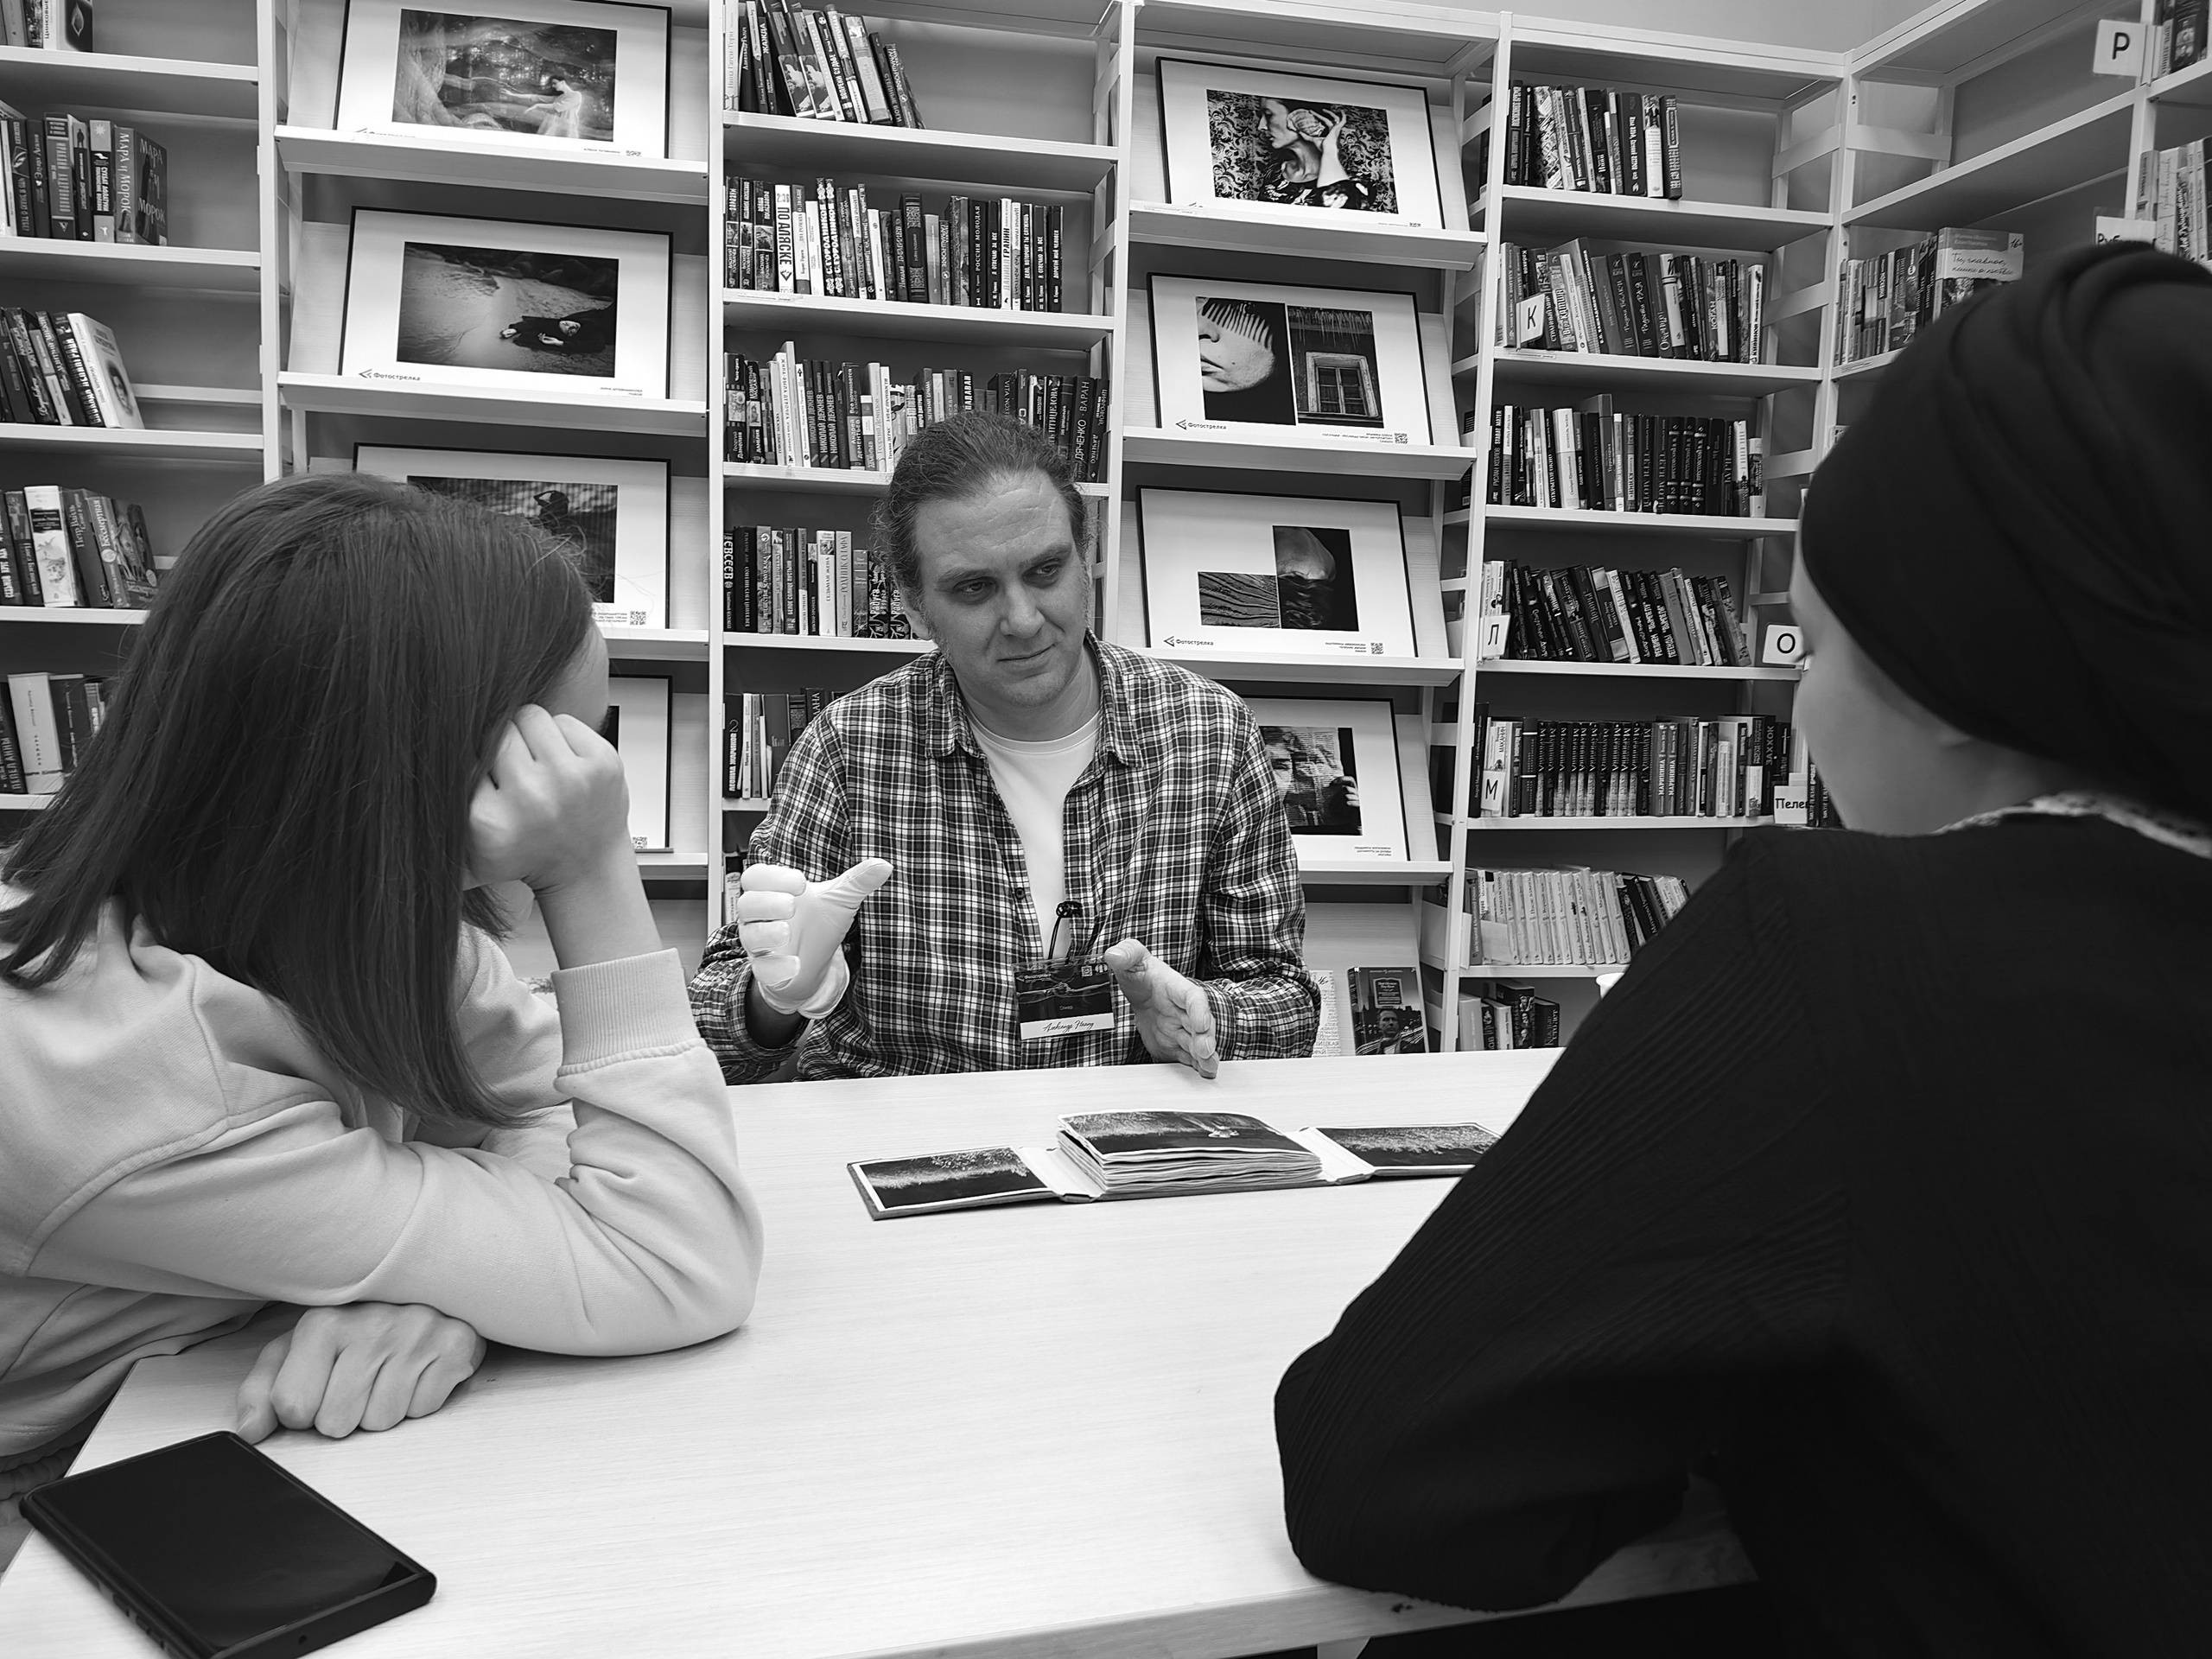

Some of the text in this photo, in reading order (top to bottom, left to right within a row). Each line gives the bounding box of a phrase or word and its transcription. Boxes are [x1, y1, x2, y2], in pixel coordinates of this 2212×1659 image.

[760, 22, 769, 54] ЖАЖДА
[2112, 32, 2130, 60] Р
[830, 54, 841, 74] СУДЬБЕ
[836, 76, 848, 99] ВОПРЕКИ
[139, 137, 163, 169] МАРА
[117, 133, 130, 213] МАРА МОРОК
[138, 197, 166, 225] МОРОК
[778, 207, 790, 219] ПО
[779, 223, 792, 265] АЛЯСКЕ
[1527, 304, 1538, 331] К
[1547, 310, 1557, 341] СТРАННЫЙ
[62, 338, 89, 387] ЛЕНИНГРАДА
[373, 372, 421, 381] Фотострелка
[79, 389, 101, 423] БЛОКАДА
[806, 390, 815, 415] ДЕЖНЕВ
[817, 394, 826, 422] ДЕЖНЕВ
[826, 394, 836, 422] ДЕЖНЕВ
[1049, 387, 1058, 433] ПТИЦЕЛОВА
[1075, 381, 1090, 461] ДЯЧЕНКО ВАРАН
[818, 423, 828, 453] НИКОЛАЙ
[829, 423, 838, 454] НИКОЛАЙ
[92, 499, 111, 547] Бессмертная
[724, 541, 734, 580] ЕВСЕЕВ
[1487, 624, 1499, 645] Л
[1650, 633, 1663, 658] РЕКВИЕМ
[1777, 632, 1796, 654] О
[1765, 726, 1774, 765] ЗАХХОК
[2, 737, 22, 789] ПЕПЕЛ АННЫ
[1485, 779, 1498, 801] М
